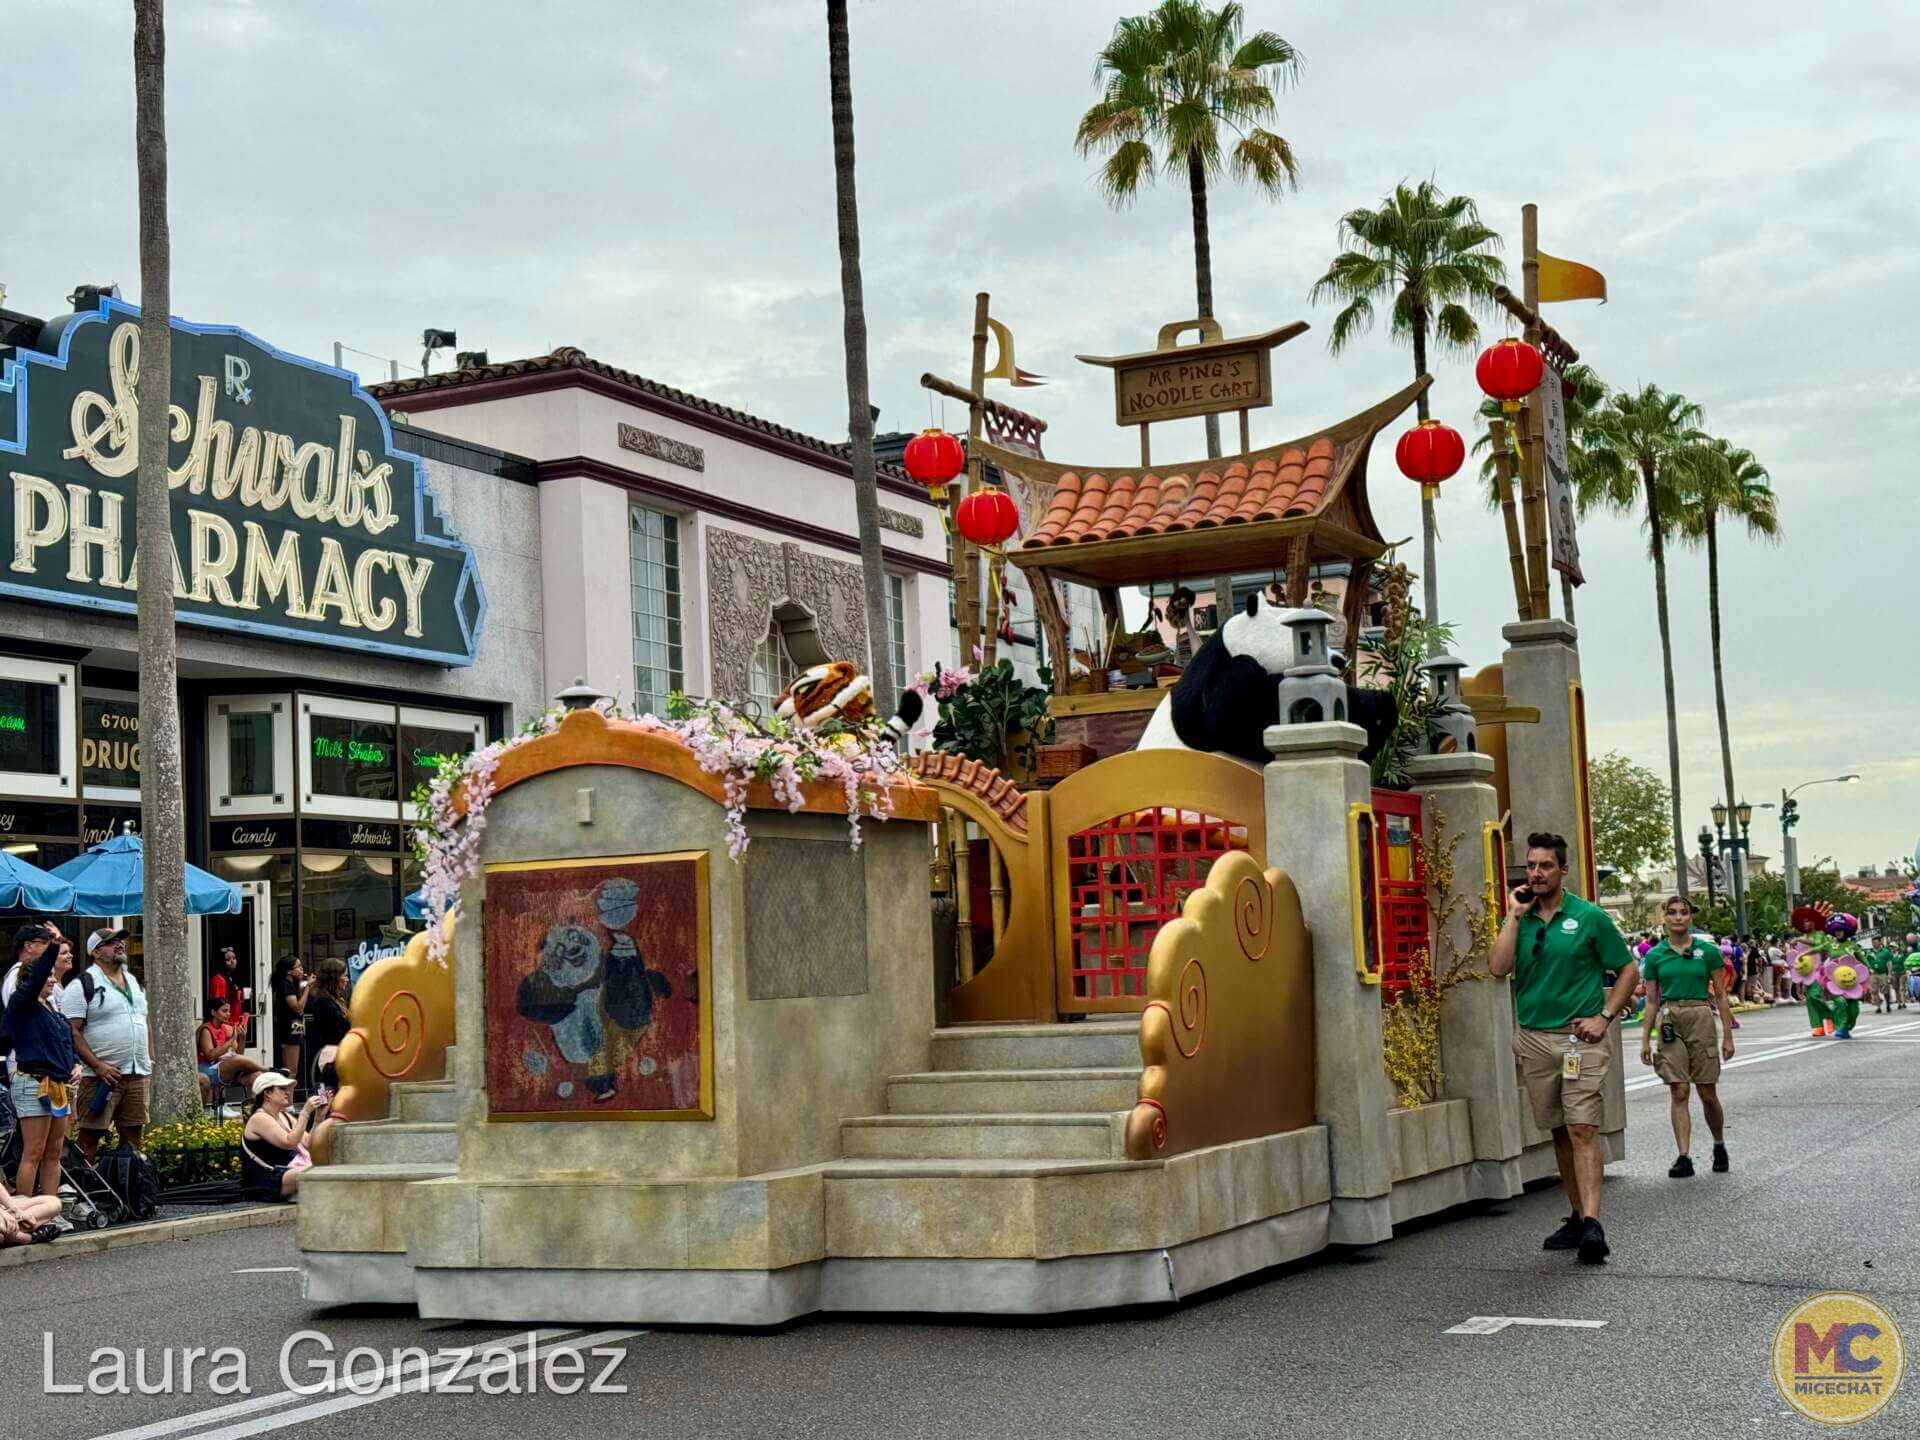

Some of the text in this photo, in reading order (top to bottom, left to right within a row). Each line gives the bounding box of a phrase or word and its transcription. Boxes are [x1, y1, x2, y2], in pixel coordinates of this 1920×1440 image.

[1148, 369, 1172, 388] MR
[1129, 380, 1254, 413] NOODLE CART
[63, 322, 400, 535] Schwab's
[101, 713, 139, 731] 6700
[313, 736, 385, 763] Milk Shakes
[232, 826, 276, 847] Candy
[350, 824, 392, 846] Schwab's
